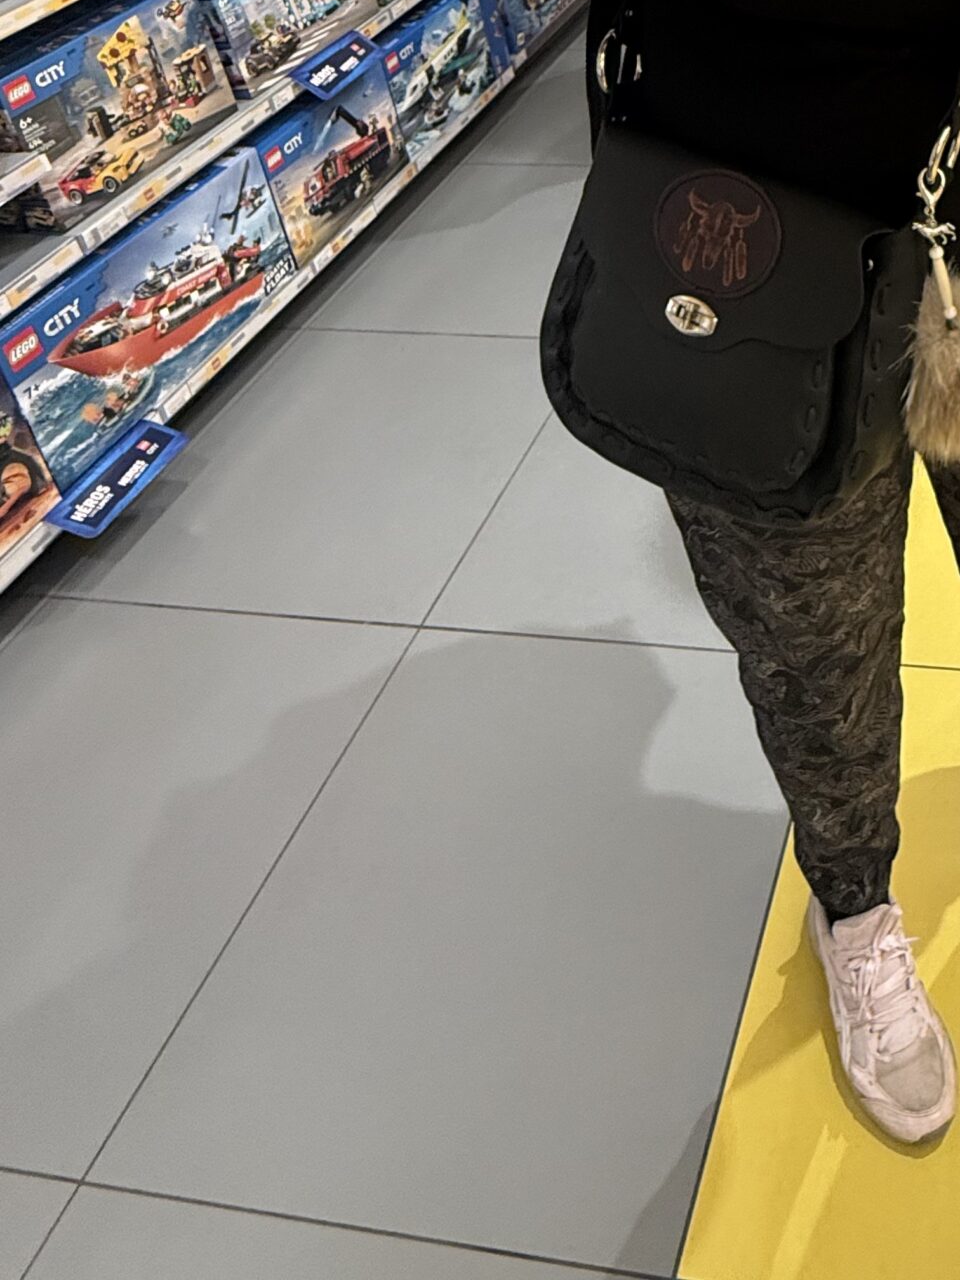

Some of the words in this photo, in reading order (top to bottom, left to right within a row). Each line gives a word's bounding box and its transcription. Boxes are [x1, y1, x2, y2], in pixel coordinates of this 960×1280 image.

[8, 81, 33, 104] LEGO
[35, 60, 66, 88] CITY
[19, 116, 33, 129] 6+
[283, 131, 303, 155] CITY
[8, 332, 40, 366] LEGO
[43, 297, 81, 337] CITY
[22, 383, 40, 399] 7+
[70, 484, 111, 522] HÉROS
